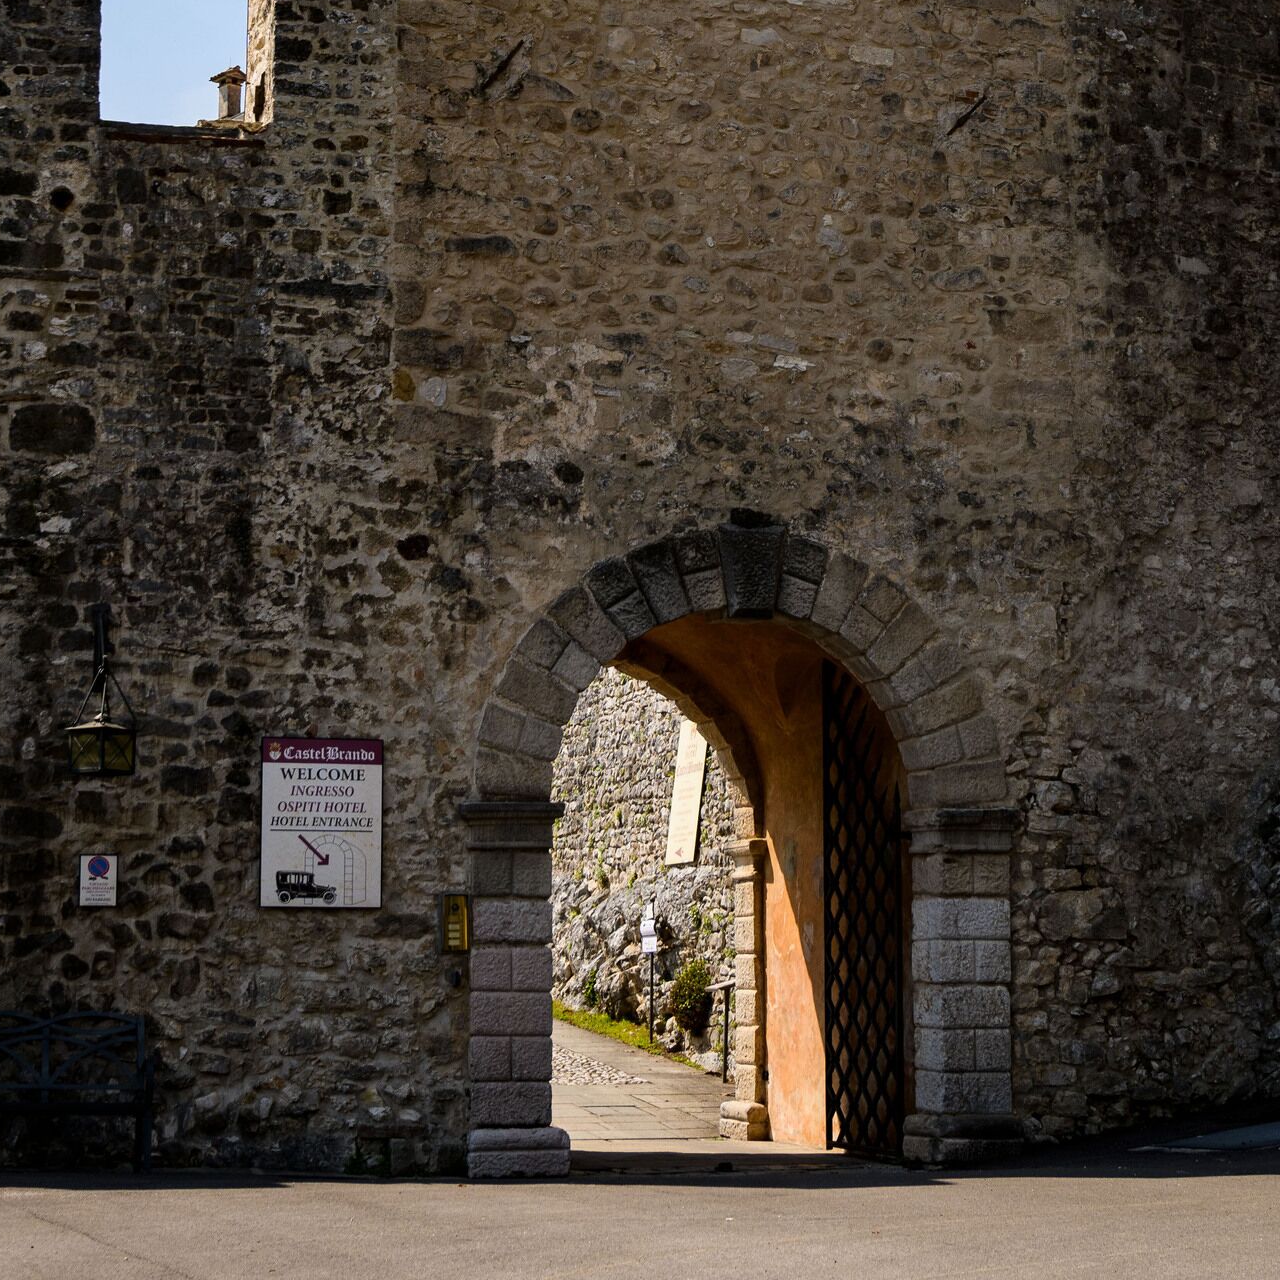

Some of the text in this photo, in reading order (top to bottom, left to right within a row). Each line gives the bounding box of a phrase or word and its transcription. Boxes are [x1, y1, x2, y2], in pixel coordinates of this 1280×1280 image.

[283, 746, 376, 762] CastelBrando
[280, 767, 366, 782] WELCOME
[290, 785, 354, 797] INGRESSO
[277, 801, 367, 814] OSPITI HOTEL
[270, 816, 373, 828] HOTEL ENTRANCE
